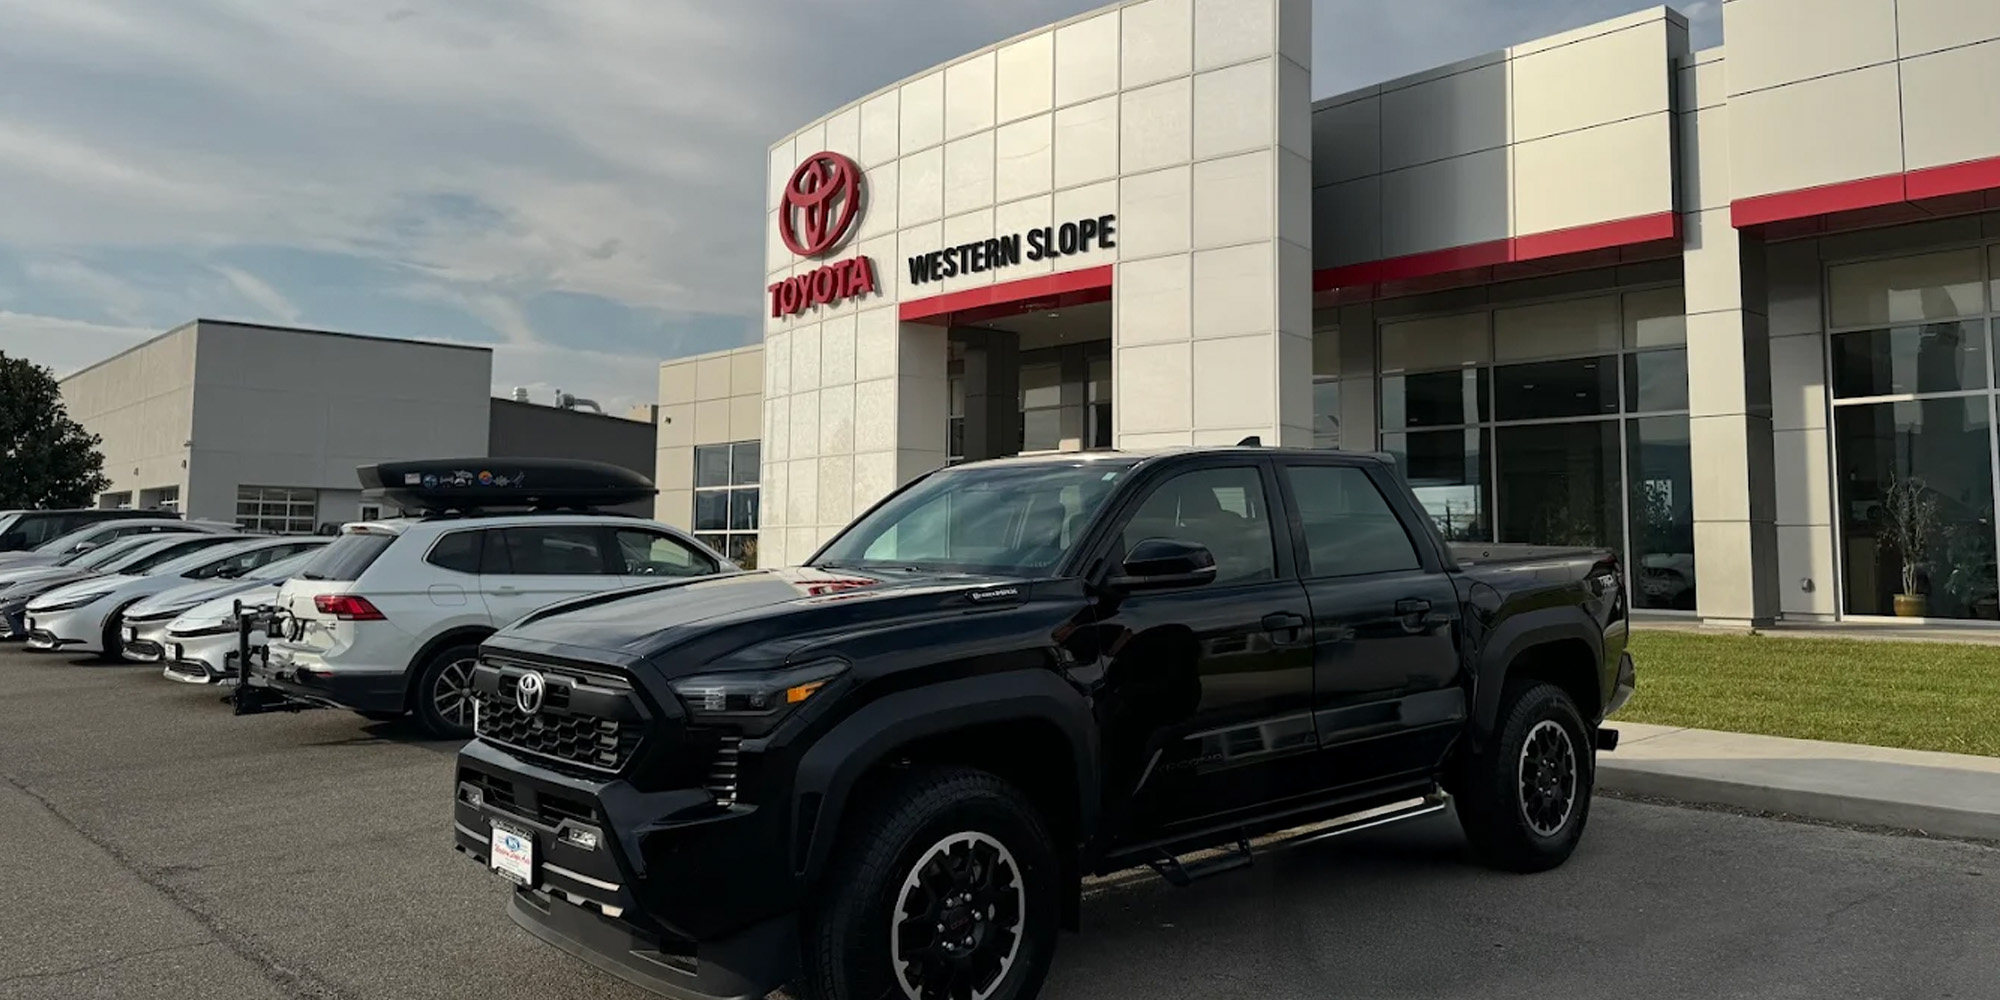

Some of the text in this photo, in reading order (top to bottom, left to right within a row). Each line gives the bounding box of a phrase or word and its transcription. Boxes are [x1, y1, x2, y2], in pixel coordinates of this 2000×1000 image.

[908, 214, 1116, 285] WESTERN SLOPE
[768, 255, 874, 318] TOYOTA
